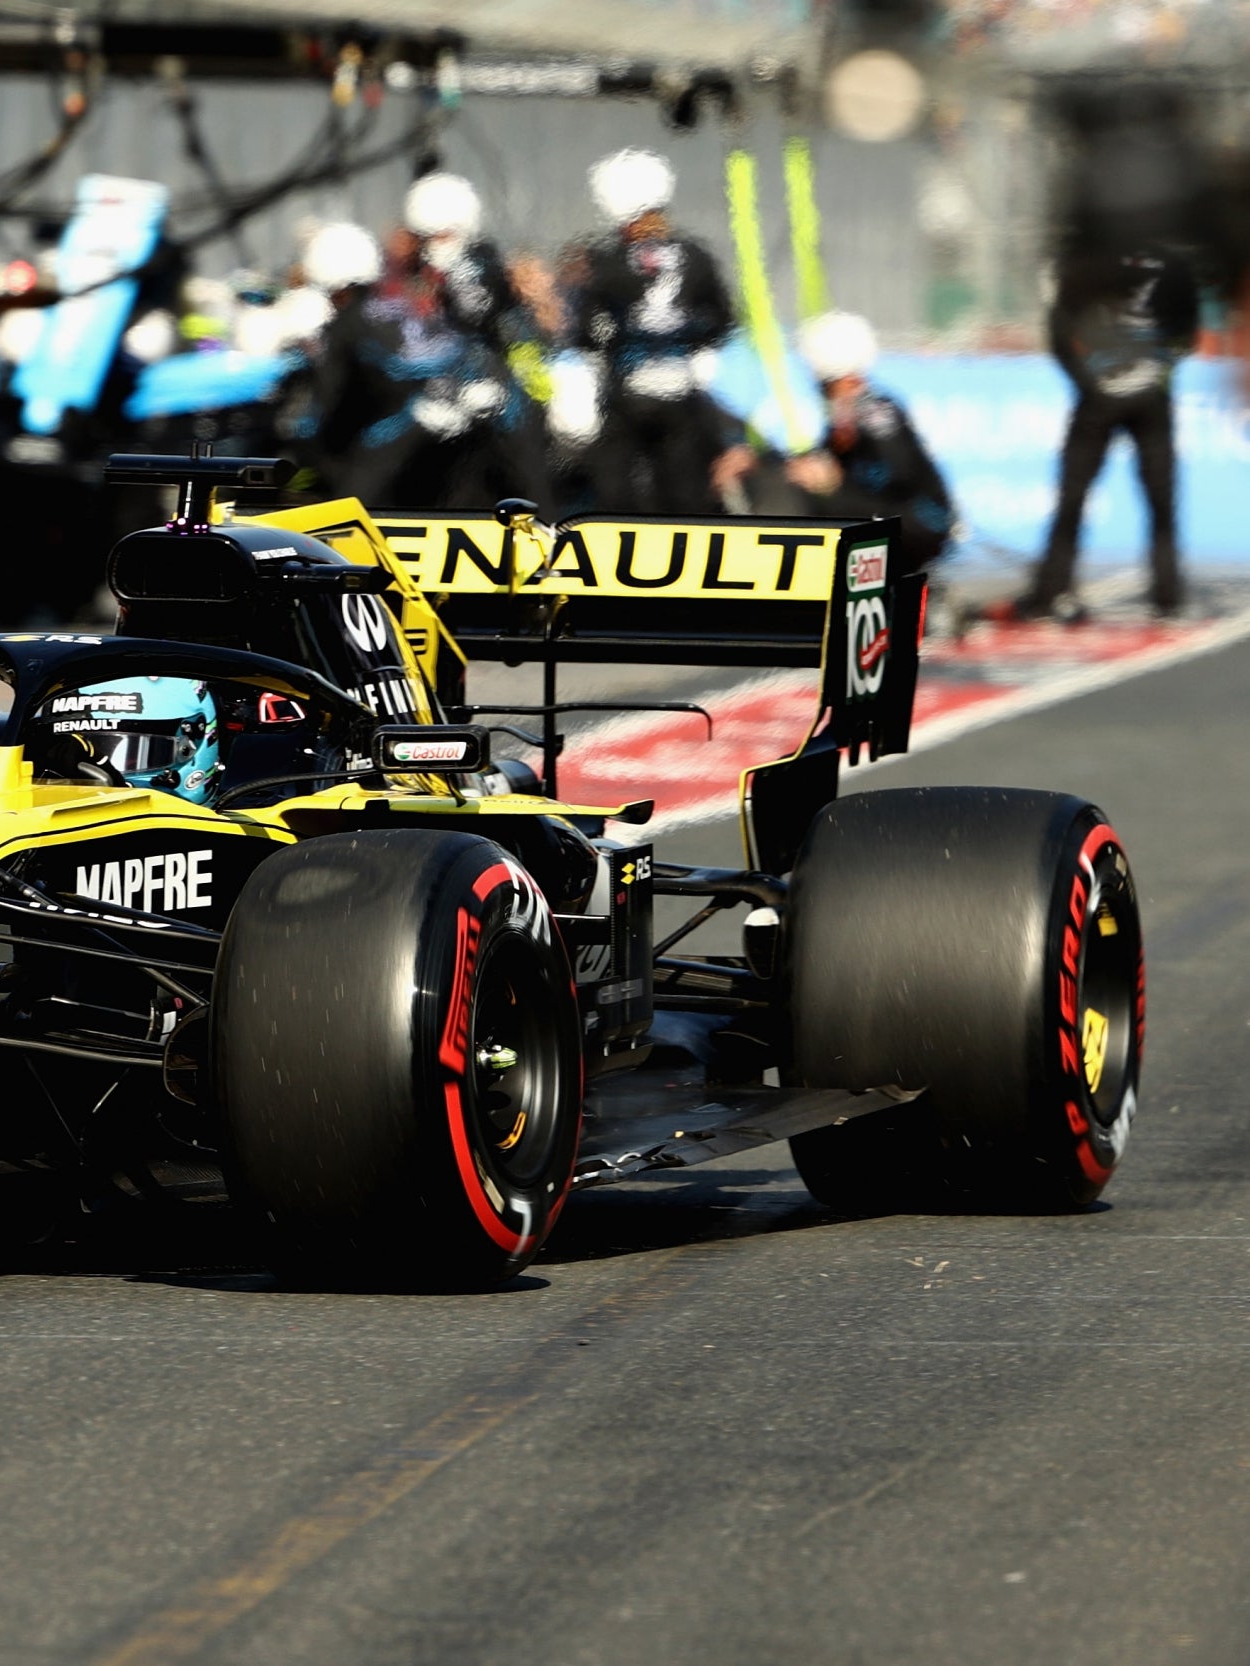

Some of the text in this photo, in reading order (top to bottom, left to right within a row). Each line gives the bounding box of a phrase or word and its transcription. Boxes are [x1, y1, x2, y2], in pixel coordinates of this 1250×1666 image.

[378, 526, 826, 590] ENAULT
[52, 695, 137, 713] MAPFRE
[53, 719, 121, 733] RENAULT
[412, 745, 460, 759] Castrol
[76, 849, 213, 912] MAPFRE
[636, 855, 651, 881] RS
[1058, 874, 1086, 1077] ZERO
